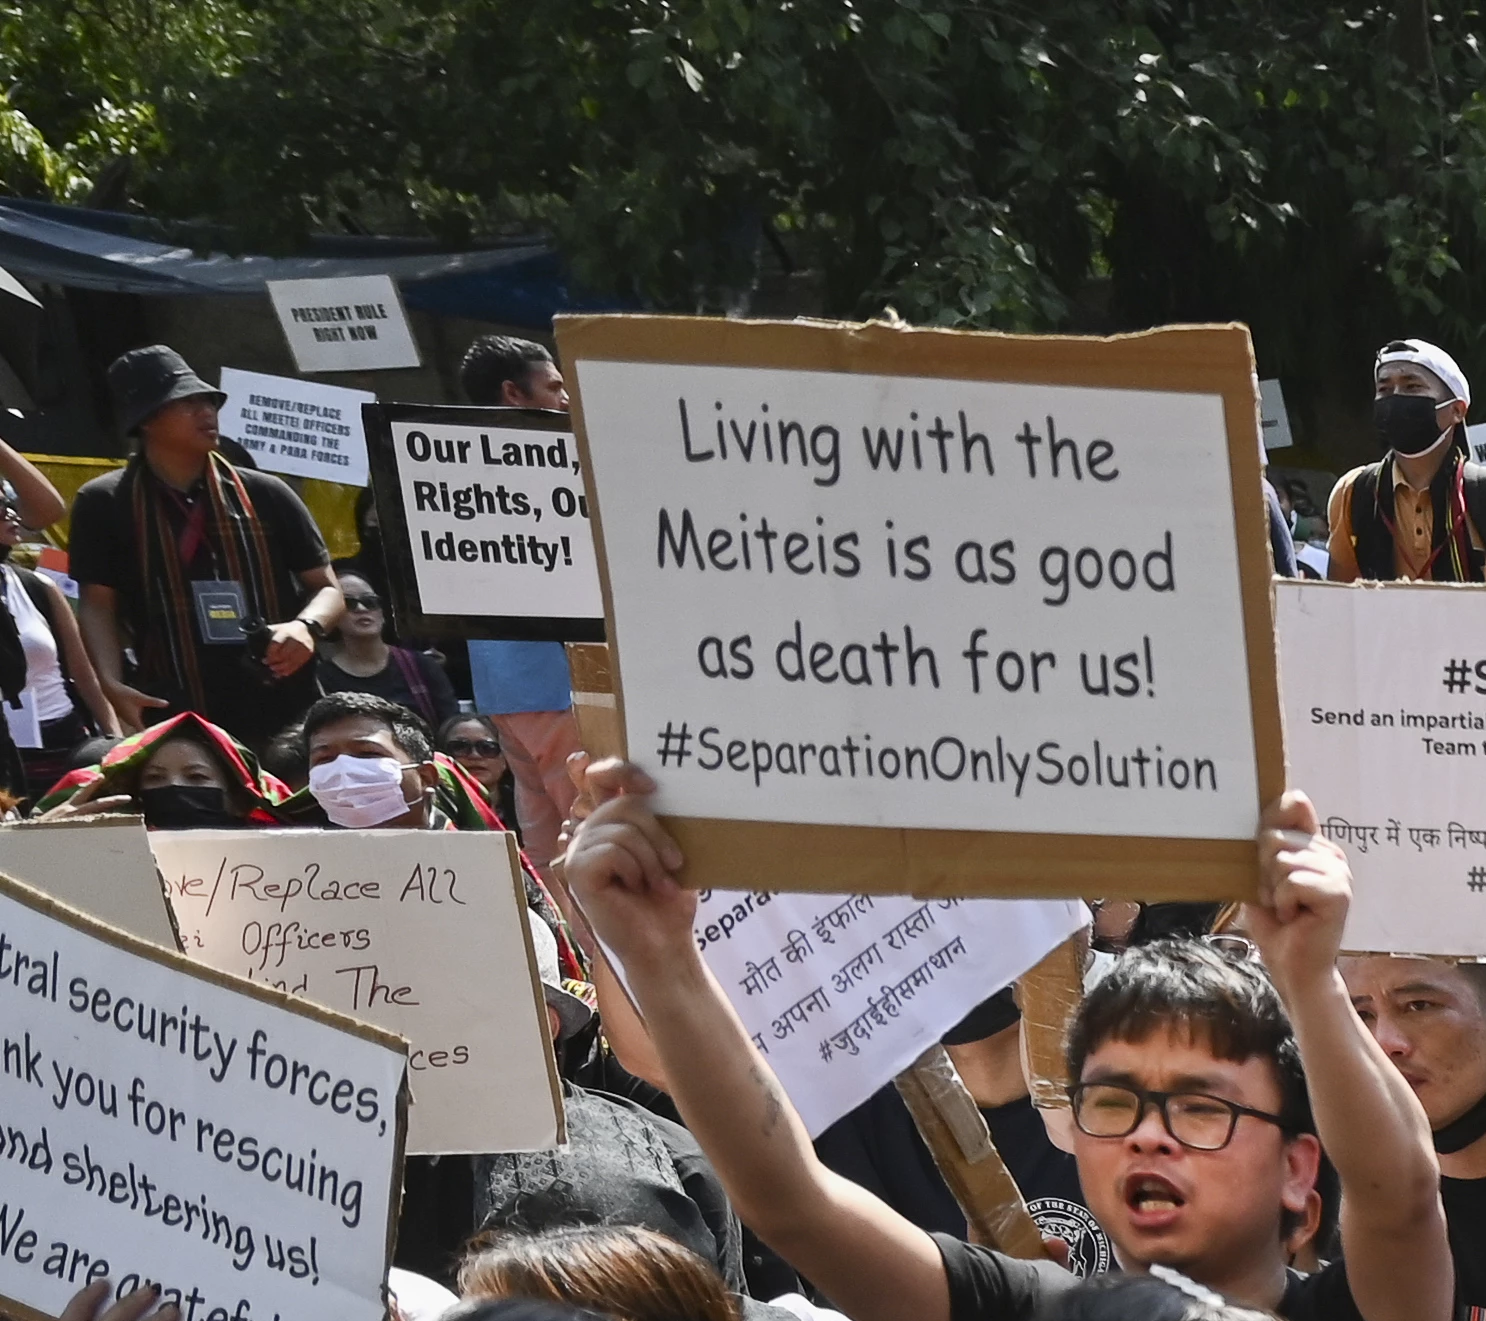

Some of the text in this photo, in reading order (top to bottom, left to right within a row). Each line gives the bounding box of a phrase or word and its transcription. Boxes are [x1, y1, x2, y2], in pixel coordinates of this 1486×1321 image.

[291, 304, 388, 322] PRESIDENT RULE
[313, 325, 378, 342] RIGHT NOW
[241, 408, 258, 421] ALL
[303, 419, 351, 436] OFFICERS
[245, 424, 339, 450] COMMANDING THE
[678, 397, 1120, 488] Living with the
[311, 450, 349, 466] FORCES
[405, 430, 582, 474] Our Land,
[413, 480, 542, 523] Rights,
[420, 530, 573, 573] Identity!
[657, 507, 1176, 607] Meiteis is as good
[697, 619, 1155, 698] as death for us!
[1310, 707, 1365, 726] Send
[1370, 713, 1394, 727] an
[656, 721, 1217, 798] #SeparationOnlySolution
[1421, 737, 1477, 756] Team
[1384, 818, 1402, 847] में
[1407, 827, 1442, 853] एक
[399, 862, 467, 905] All
[242, 921, 370, 969] Officers
[740, 956, 782, 997] मौत
[780, 930, 814, 964] की
[335, 964, 420, 1011] The
[771, 904, 936, 1040] अपना अलग रास्ता
[68, 977, 238, 1083] security
[246, 1029, 387, 1138] forces,
[51, 1060, 118, 1118] you
[127, 1077, 186, 1142] for
[196, 1118, 363, 1229] rescuing
[62, 1143, 256, 1283] sheltering
[264, 1234, 320, 1286] us!
[43, 1240, 109, 1286] are
